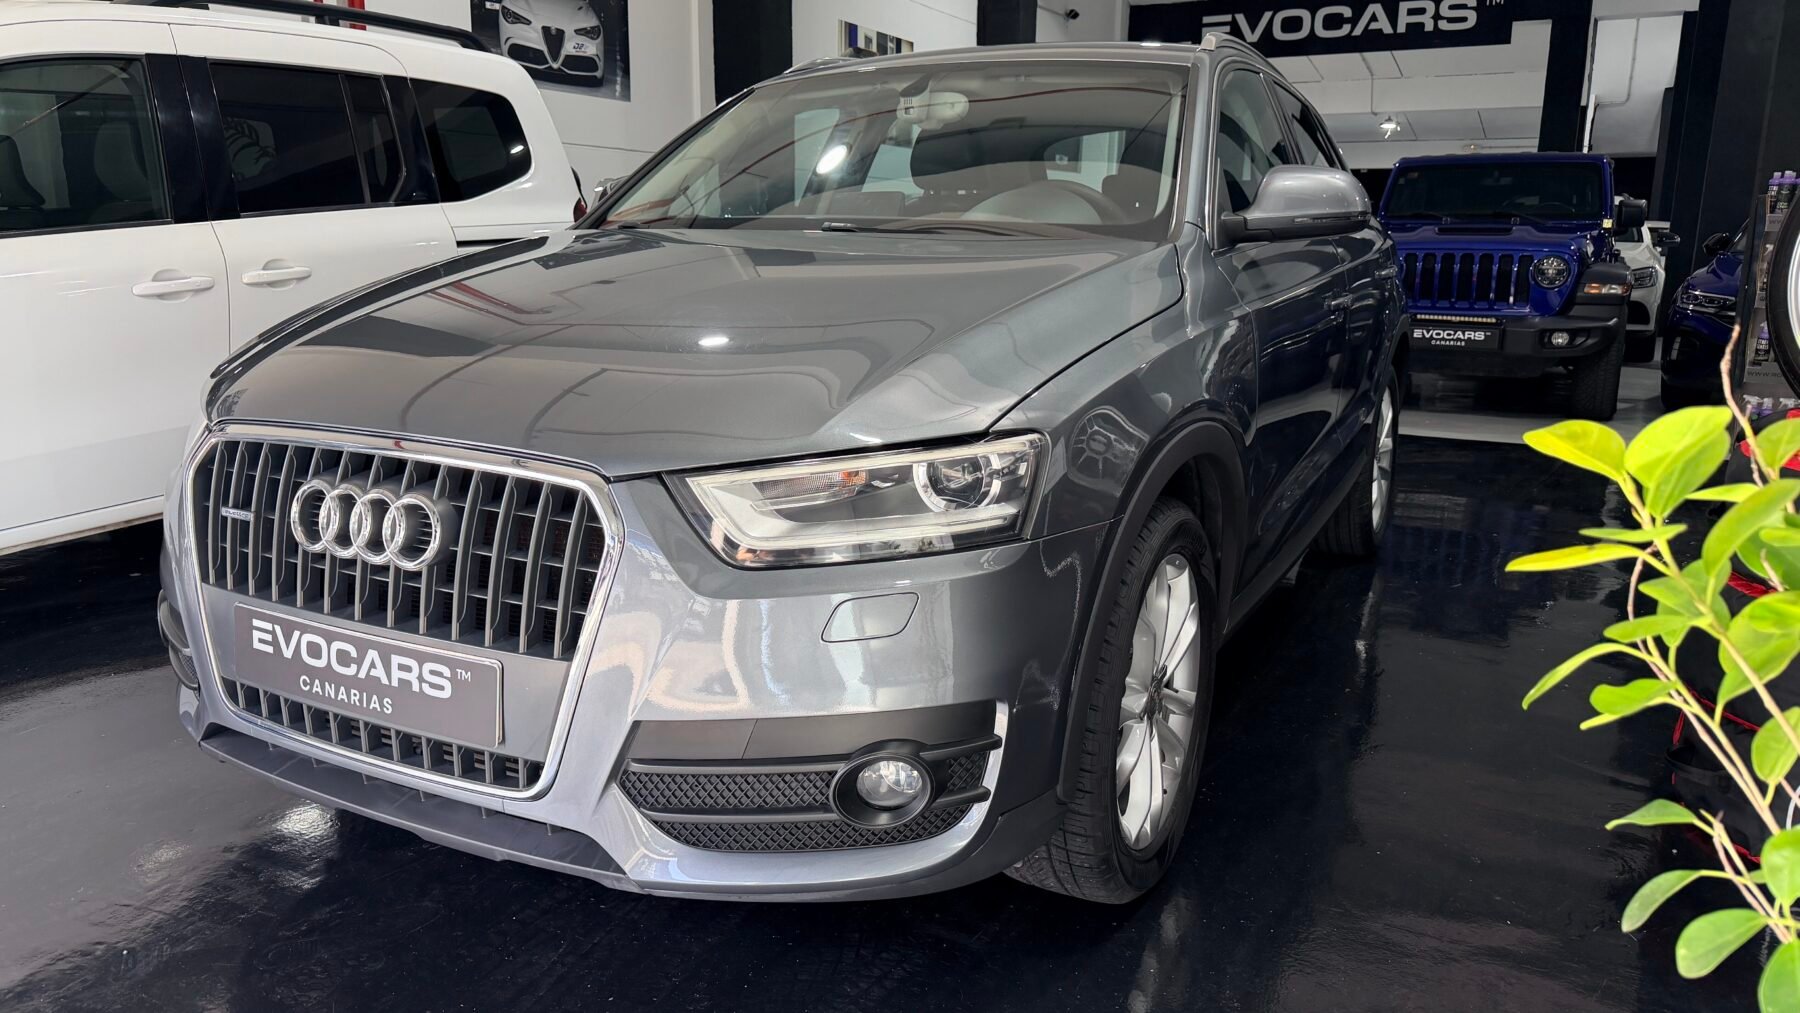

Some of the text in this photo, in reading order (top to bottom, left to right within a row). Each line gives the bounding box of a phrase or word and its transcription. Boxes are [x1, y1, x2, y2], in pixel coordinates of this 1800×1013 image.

[1202, 0, 1477, 42] EVOCARS
[1413, 329, 1485, 340] EVOCARS
[252, 618, 452, 699] EVOCARS
[299, 675, 393, 714] CANARIAS
